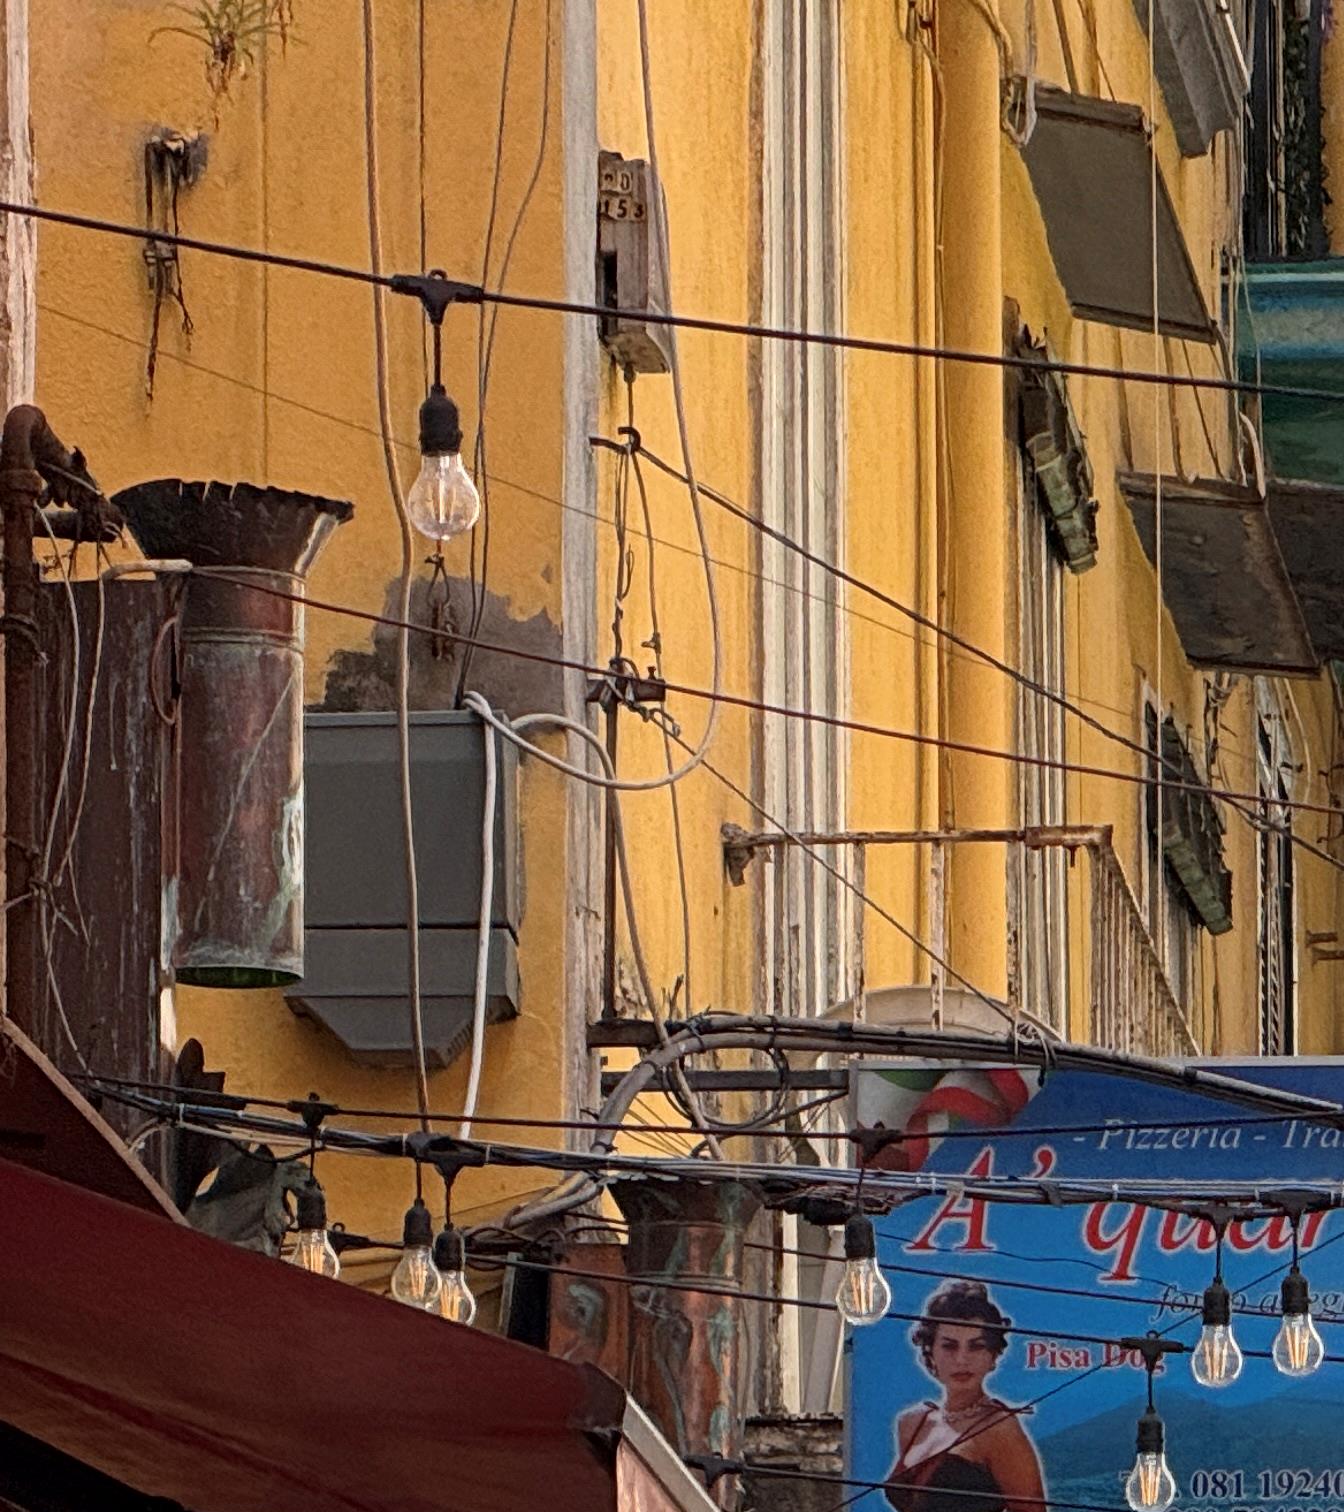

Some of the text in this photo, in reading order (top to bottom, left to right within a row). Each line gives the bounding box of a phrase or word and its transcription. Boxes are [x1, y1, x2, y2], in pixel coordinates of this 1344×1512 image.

[1099, 1118, 1241, 1151] Pizzeria
[1026, 1341, 1091, 1369] Pisa
[1191, 1470, 1245, 1500] 081
